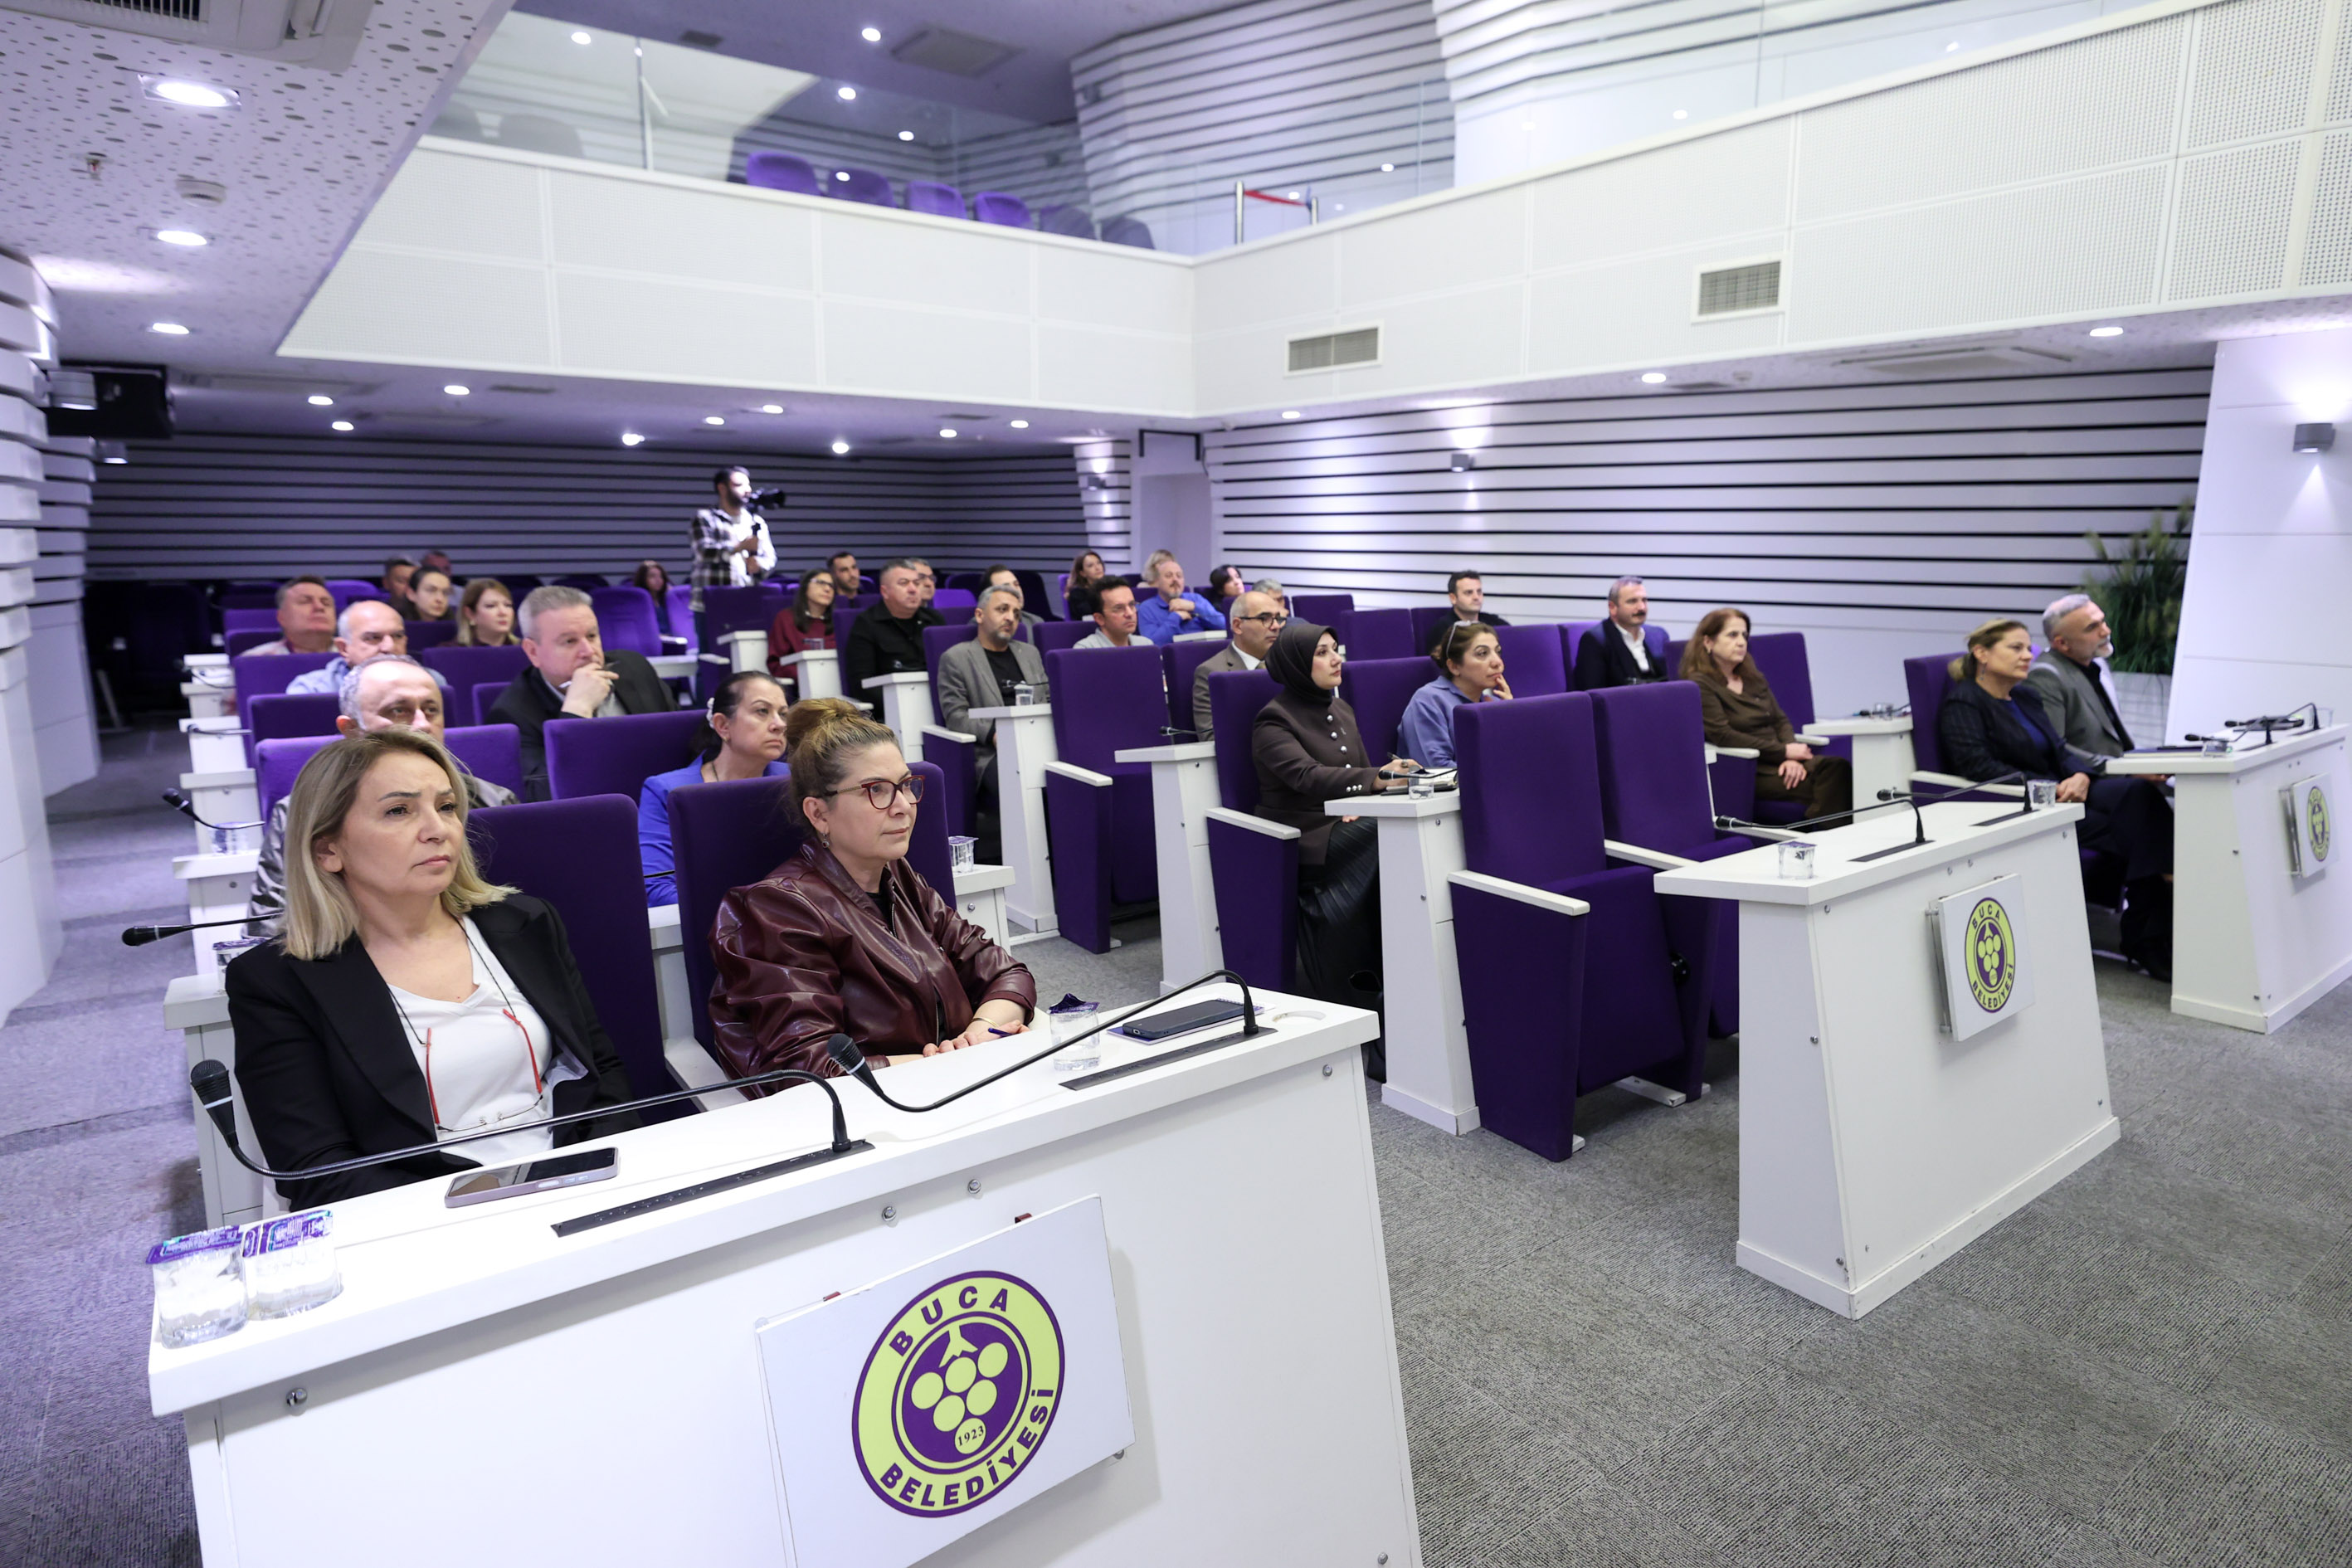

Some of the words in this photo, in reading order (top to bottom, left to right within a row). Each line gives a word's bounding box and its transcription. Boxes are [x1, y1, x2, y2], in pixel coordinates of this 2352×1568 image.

[1972, 904, 2000, 929] BUCA
[1973, 964, 2014, 1008] BELEDİYESİ
[889, 1286, 1008, 1356] BUCA
[880, 1389, 1054, 1507] BELEDİYESİ
[957, 1425, 985, 1446] 1923
